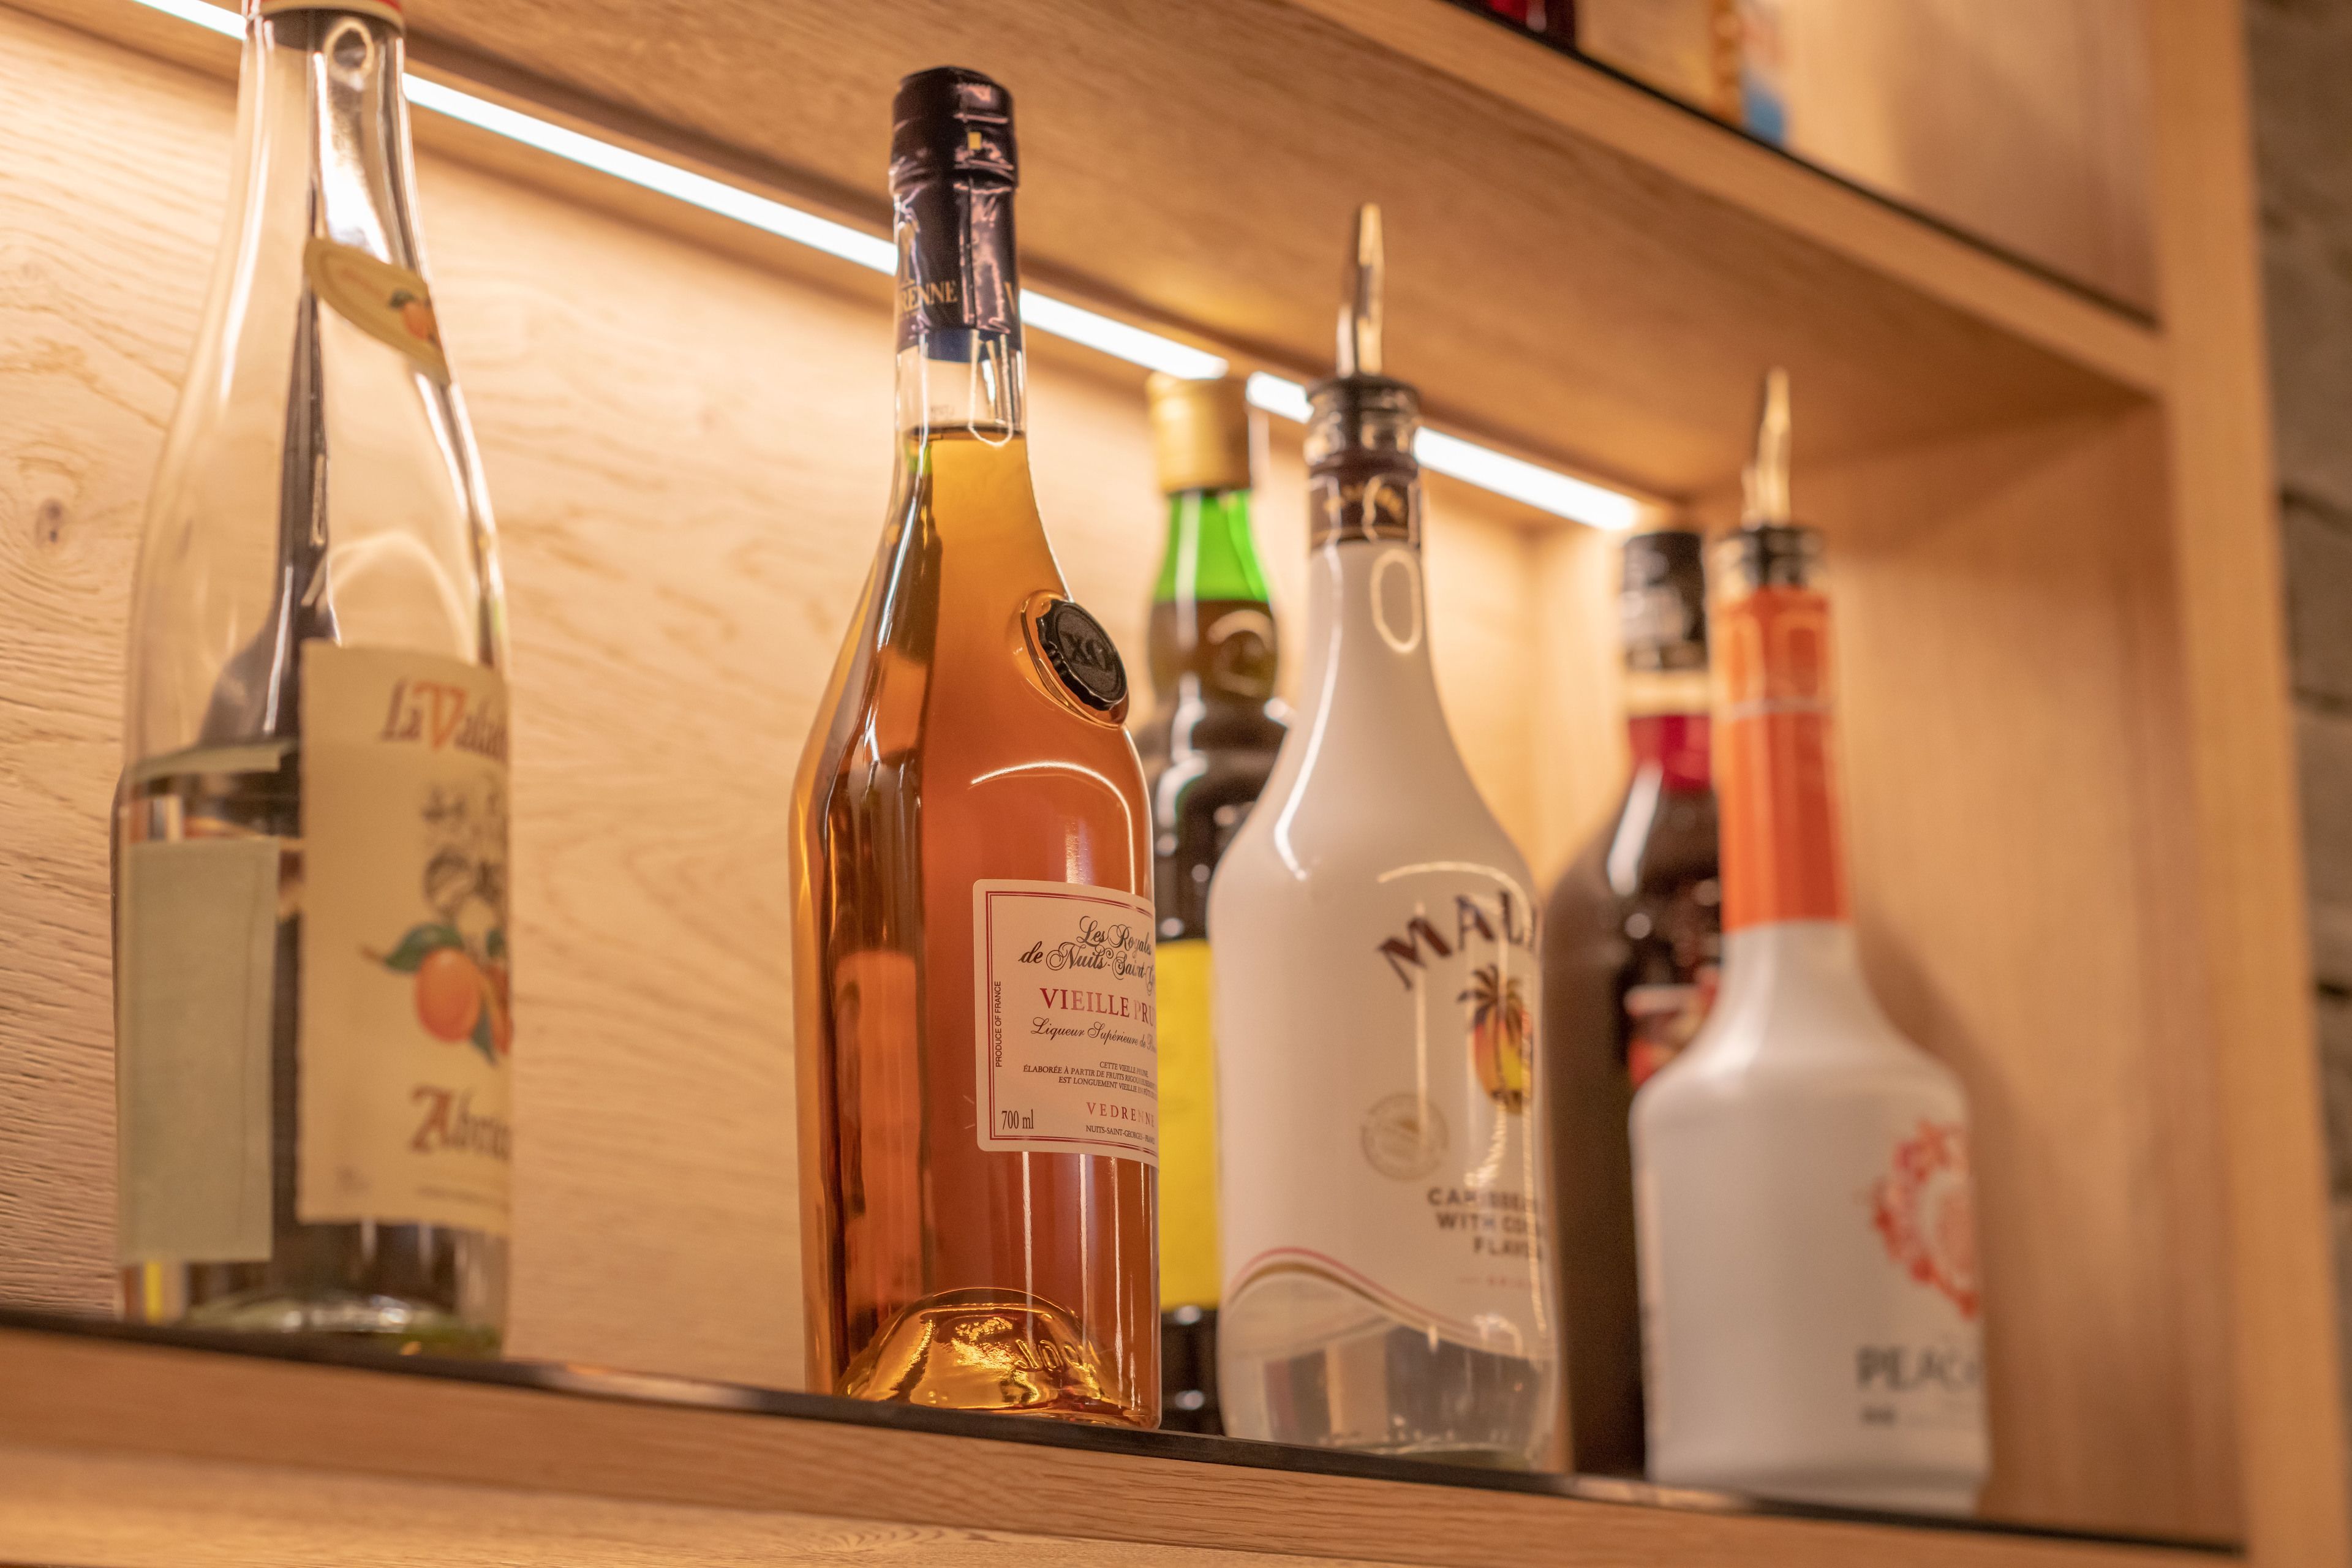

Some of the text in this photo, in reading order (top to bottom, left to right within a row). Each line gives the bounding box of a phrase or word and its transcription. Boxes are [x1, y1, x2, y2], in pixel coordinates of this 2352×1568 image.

[1077, 916, 1152, 959] Les Royales
[1018, 941, 1043, 964] de
[1039, 988, 1130, 1018] VIEILLE
[995, 1015, 1002, 1027] OF
[1030, 1017, 1085, 1041] Liqueur
[1087, 1021, 1139, 1046] Supérieure
[1139, 1034, 1147, 1049] de
[1023, 1064, 1062, 1074] ÉLABORÉE
[1064, 1066, 1069, 1074] À
[1071, 1068, 1095, 1077] PARTIR
[1106, 1072, 1124, 1081] FRUITS
[1099, 1061, 1118, 1071] CETTE
[1119, 1064, 1136, 1074] VIEILLE
[1073, 1077, 1118, 1088] LONGUEMENT
[1001, 1109, 1034, 1130] 700 ml
[1086, 1102, 1155, 1128] VEDRENNE
[1086, 1125, 1143, 1140] NUITS-SAINT-GEORGES
